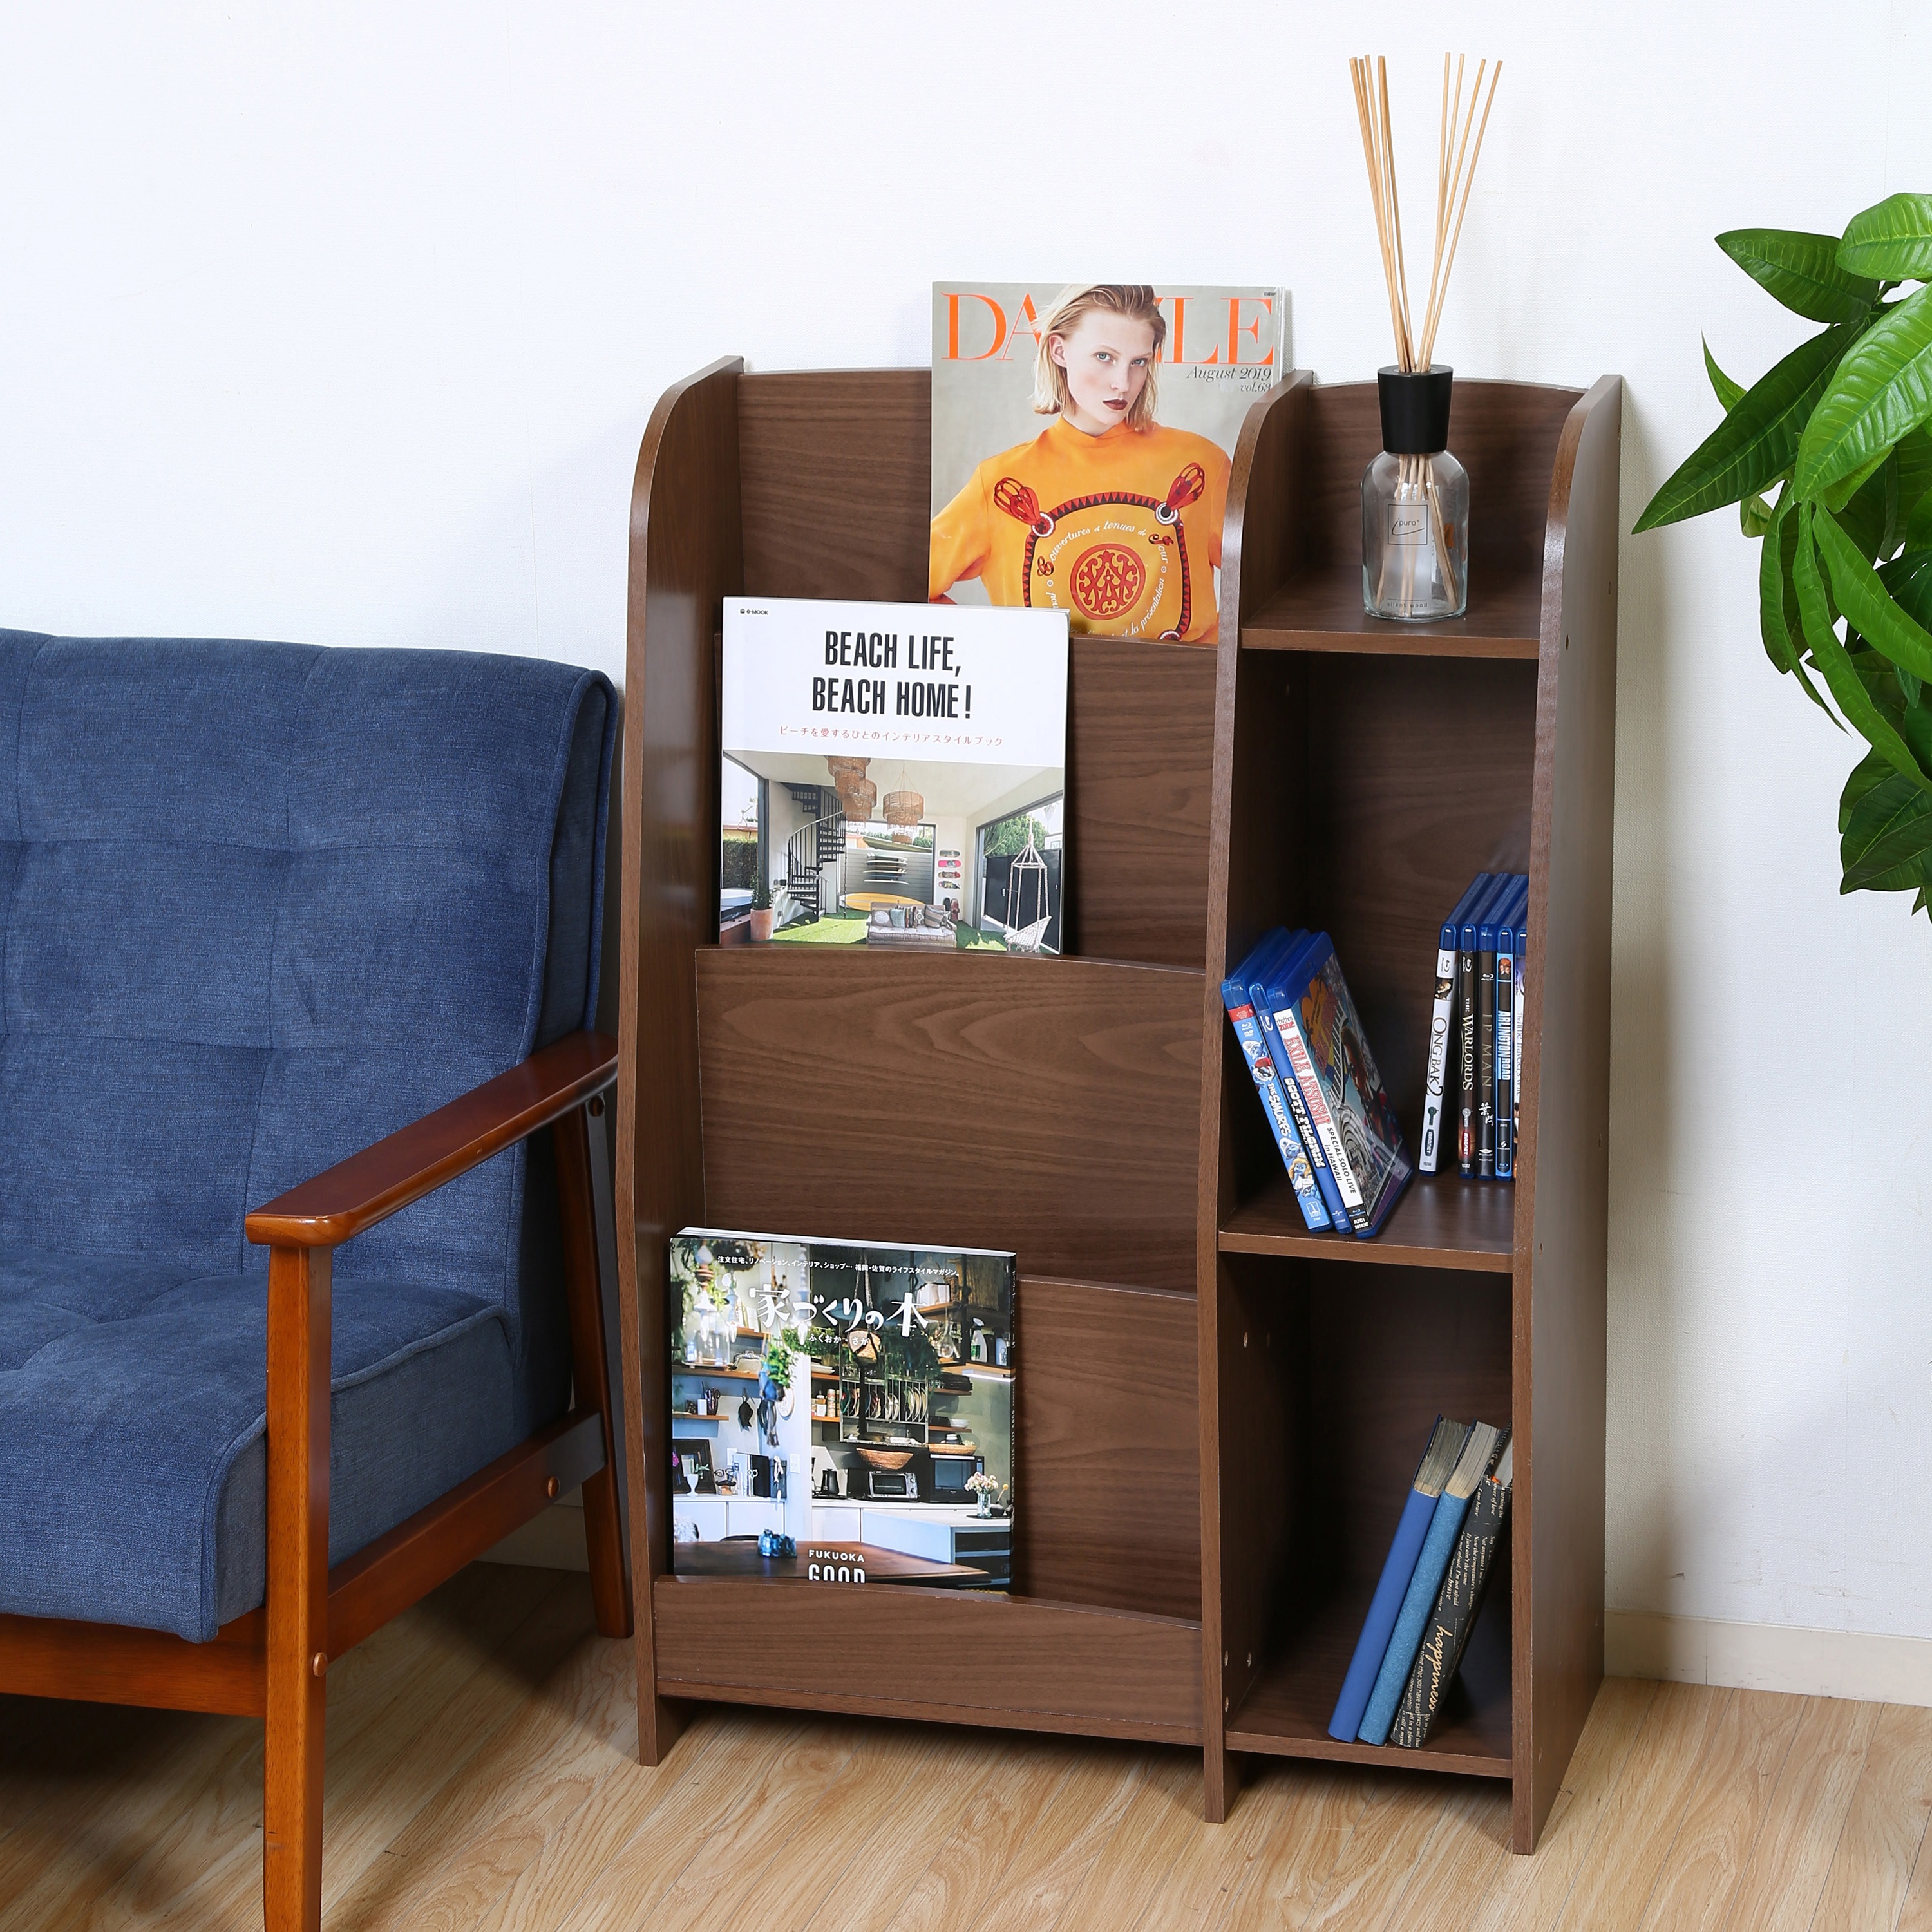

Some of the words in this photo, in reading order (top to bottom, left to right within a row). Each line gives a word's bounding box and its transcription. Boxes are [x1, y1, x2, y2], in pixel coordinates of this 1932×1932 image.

[939, 291, 1274, 365] DALE
[1186, 366, 1236, 382] August
[1239, 367, 1271, 381] 2019
[1103, 520, 1135, 533] tenues
[1130, 622, 1140, 636] la
[824, 630, 898, 668] BEACH
[908, 635, 961, 677] LIFE,
[812, 677, 886, 714] BEACH
[896, 681, 971, 719] HOME!
[780, 725, 1003, 747] ビーチを愛するひとのインテリアスタイルブック
[1432, 1017, 1447, 1056] ONG
[1482, 1014, 1492, 1032] IP
[1498, 1010, 1511, 1057] ARLINGTON
[1283, 1035, 1311, 1073] EXILE
[1462, 1014, 1473, 1090] WARLORDS
[1482, 1043, 1492, 1087] MAN
[1429, 1058, 1441, 1085] BAK
[1501, 1057, 1511, 1081] ROAD
[1267, 1083, 1277, 1096] THE
[1426, 1083, 1444, 1097] 2
[1268, 1094, 1291, 1137] SMURFS
[1283, 1077, 1306, 1115] SCOTT
[1300, 1115, 1326, 1168] PILGRIM
[1327, 1127, 1343, 1157] SPECIAL
[1338, 1157, 1349, 1177] SOLO
[1346, 1177, 1356, 1193] LIVE
[1327, 1152, 1343, 1181] HAWAII
[749, 1284, 929, 1337] 家づくりの本
[808, 1549, 864, 1563] FUKUOKA
[808, 1564, 865, 1583] GOOD
[1446, 1578, 1455, 1600] brave
[1425, 1625, 1453, 1712] happiness
